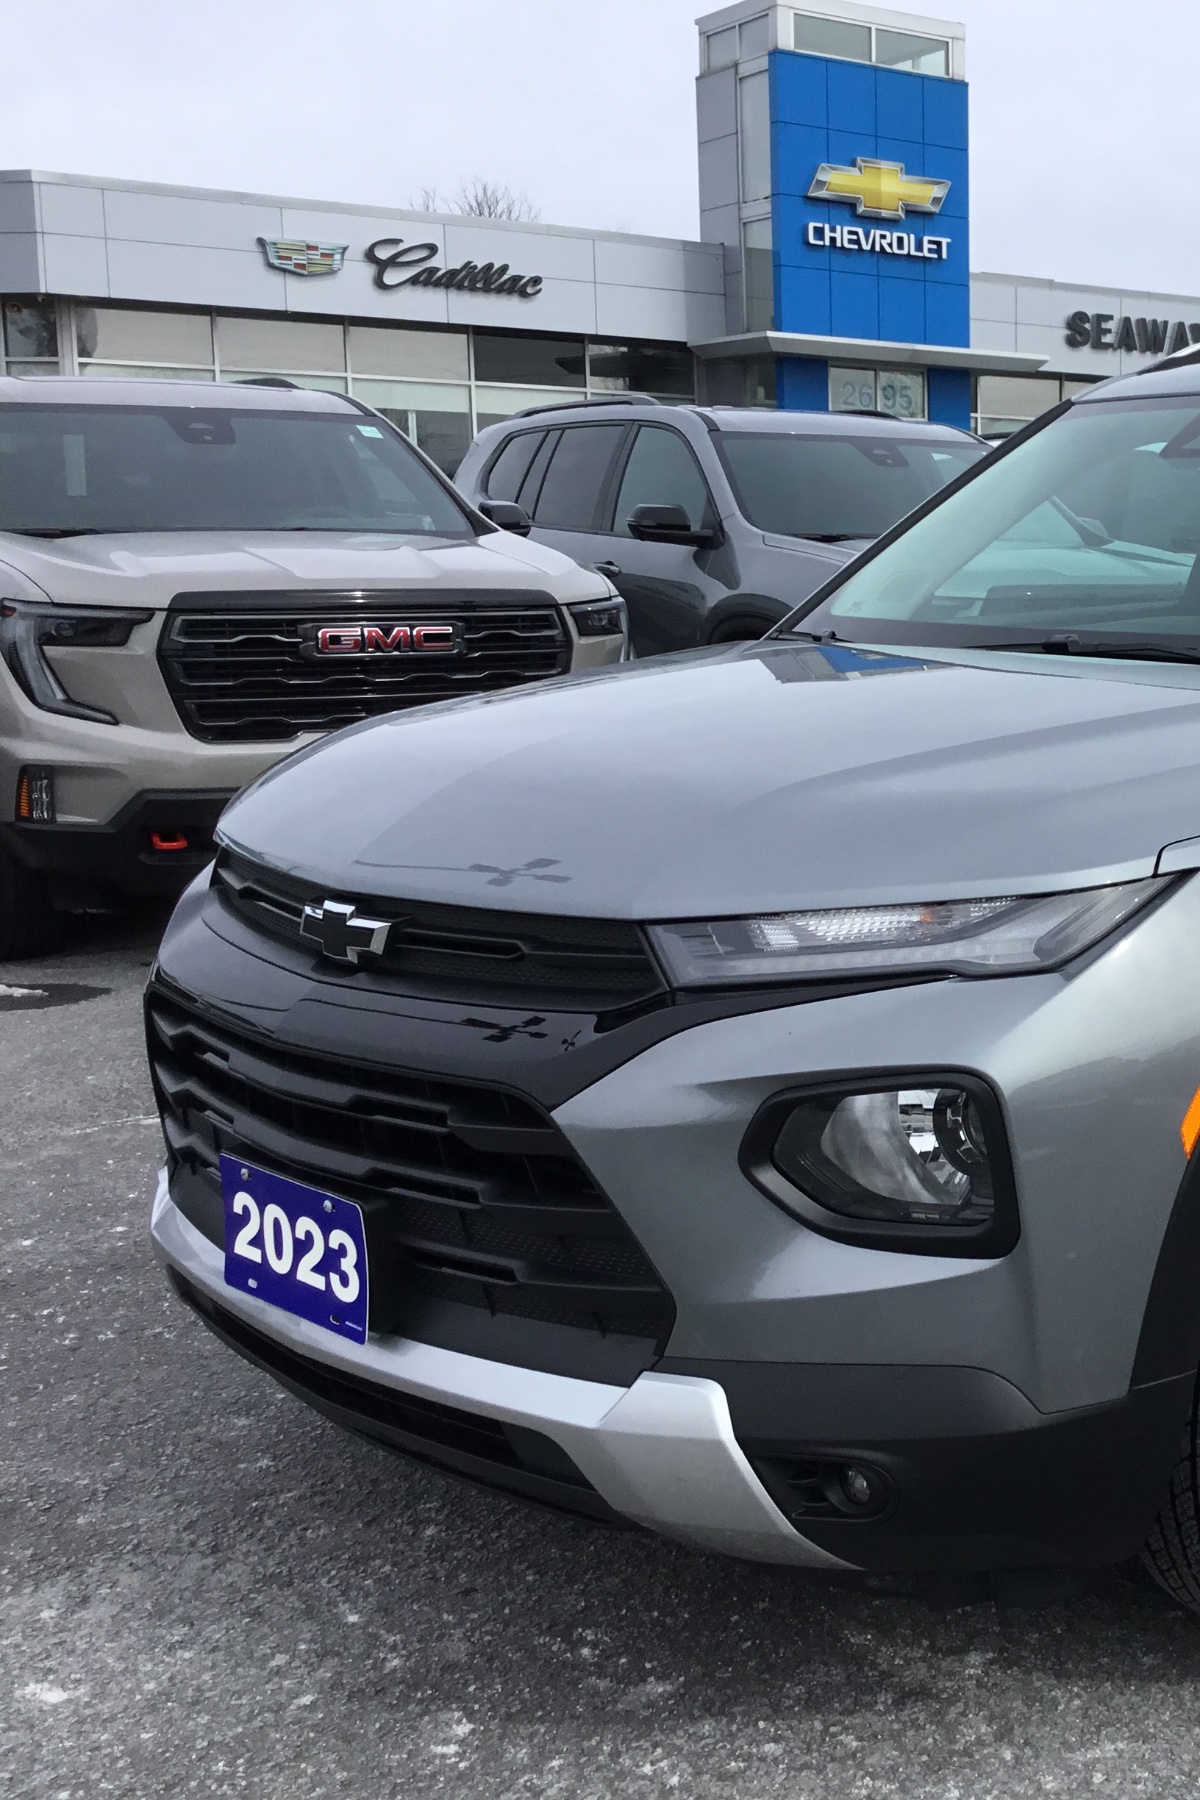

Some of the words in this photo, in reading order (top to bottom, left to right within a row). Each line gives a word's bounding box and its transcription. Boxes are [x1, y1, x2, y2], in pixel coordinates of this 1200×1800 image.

[808, 221, 952, 260] CHEVROLET
[365, 238, 543, 298] Cadillac
[318, 626, 454, 653] GMC
[233, 1191, 360, 1303] 2023
